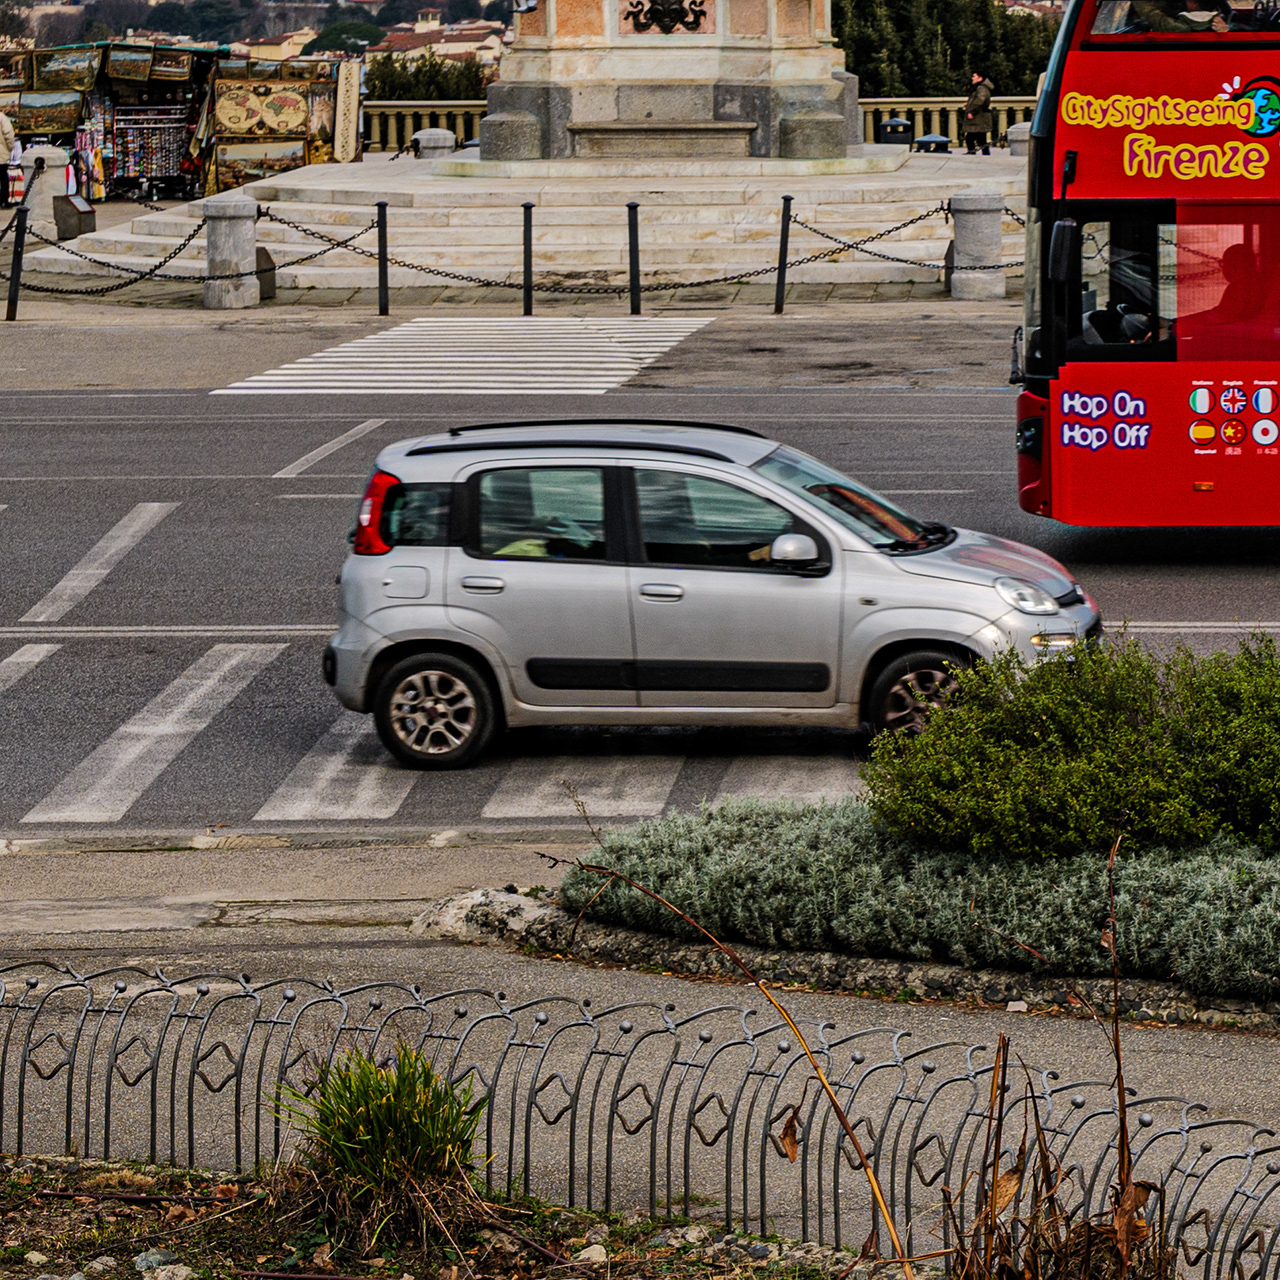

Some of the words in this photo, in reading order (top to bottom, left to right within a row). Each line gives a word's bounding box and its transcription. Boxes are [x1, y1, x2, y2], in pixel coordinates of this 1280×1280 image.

[1125, 134, 1269, 179] Firenze
[1062, 392, 1109, 419] Hop
[1113, 391, 1145, 417] On
[1062, 423, 1109, 450] Hop
[1113, 422, 1151, 447] Off
